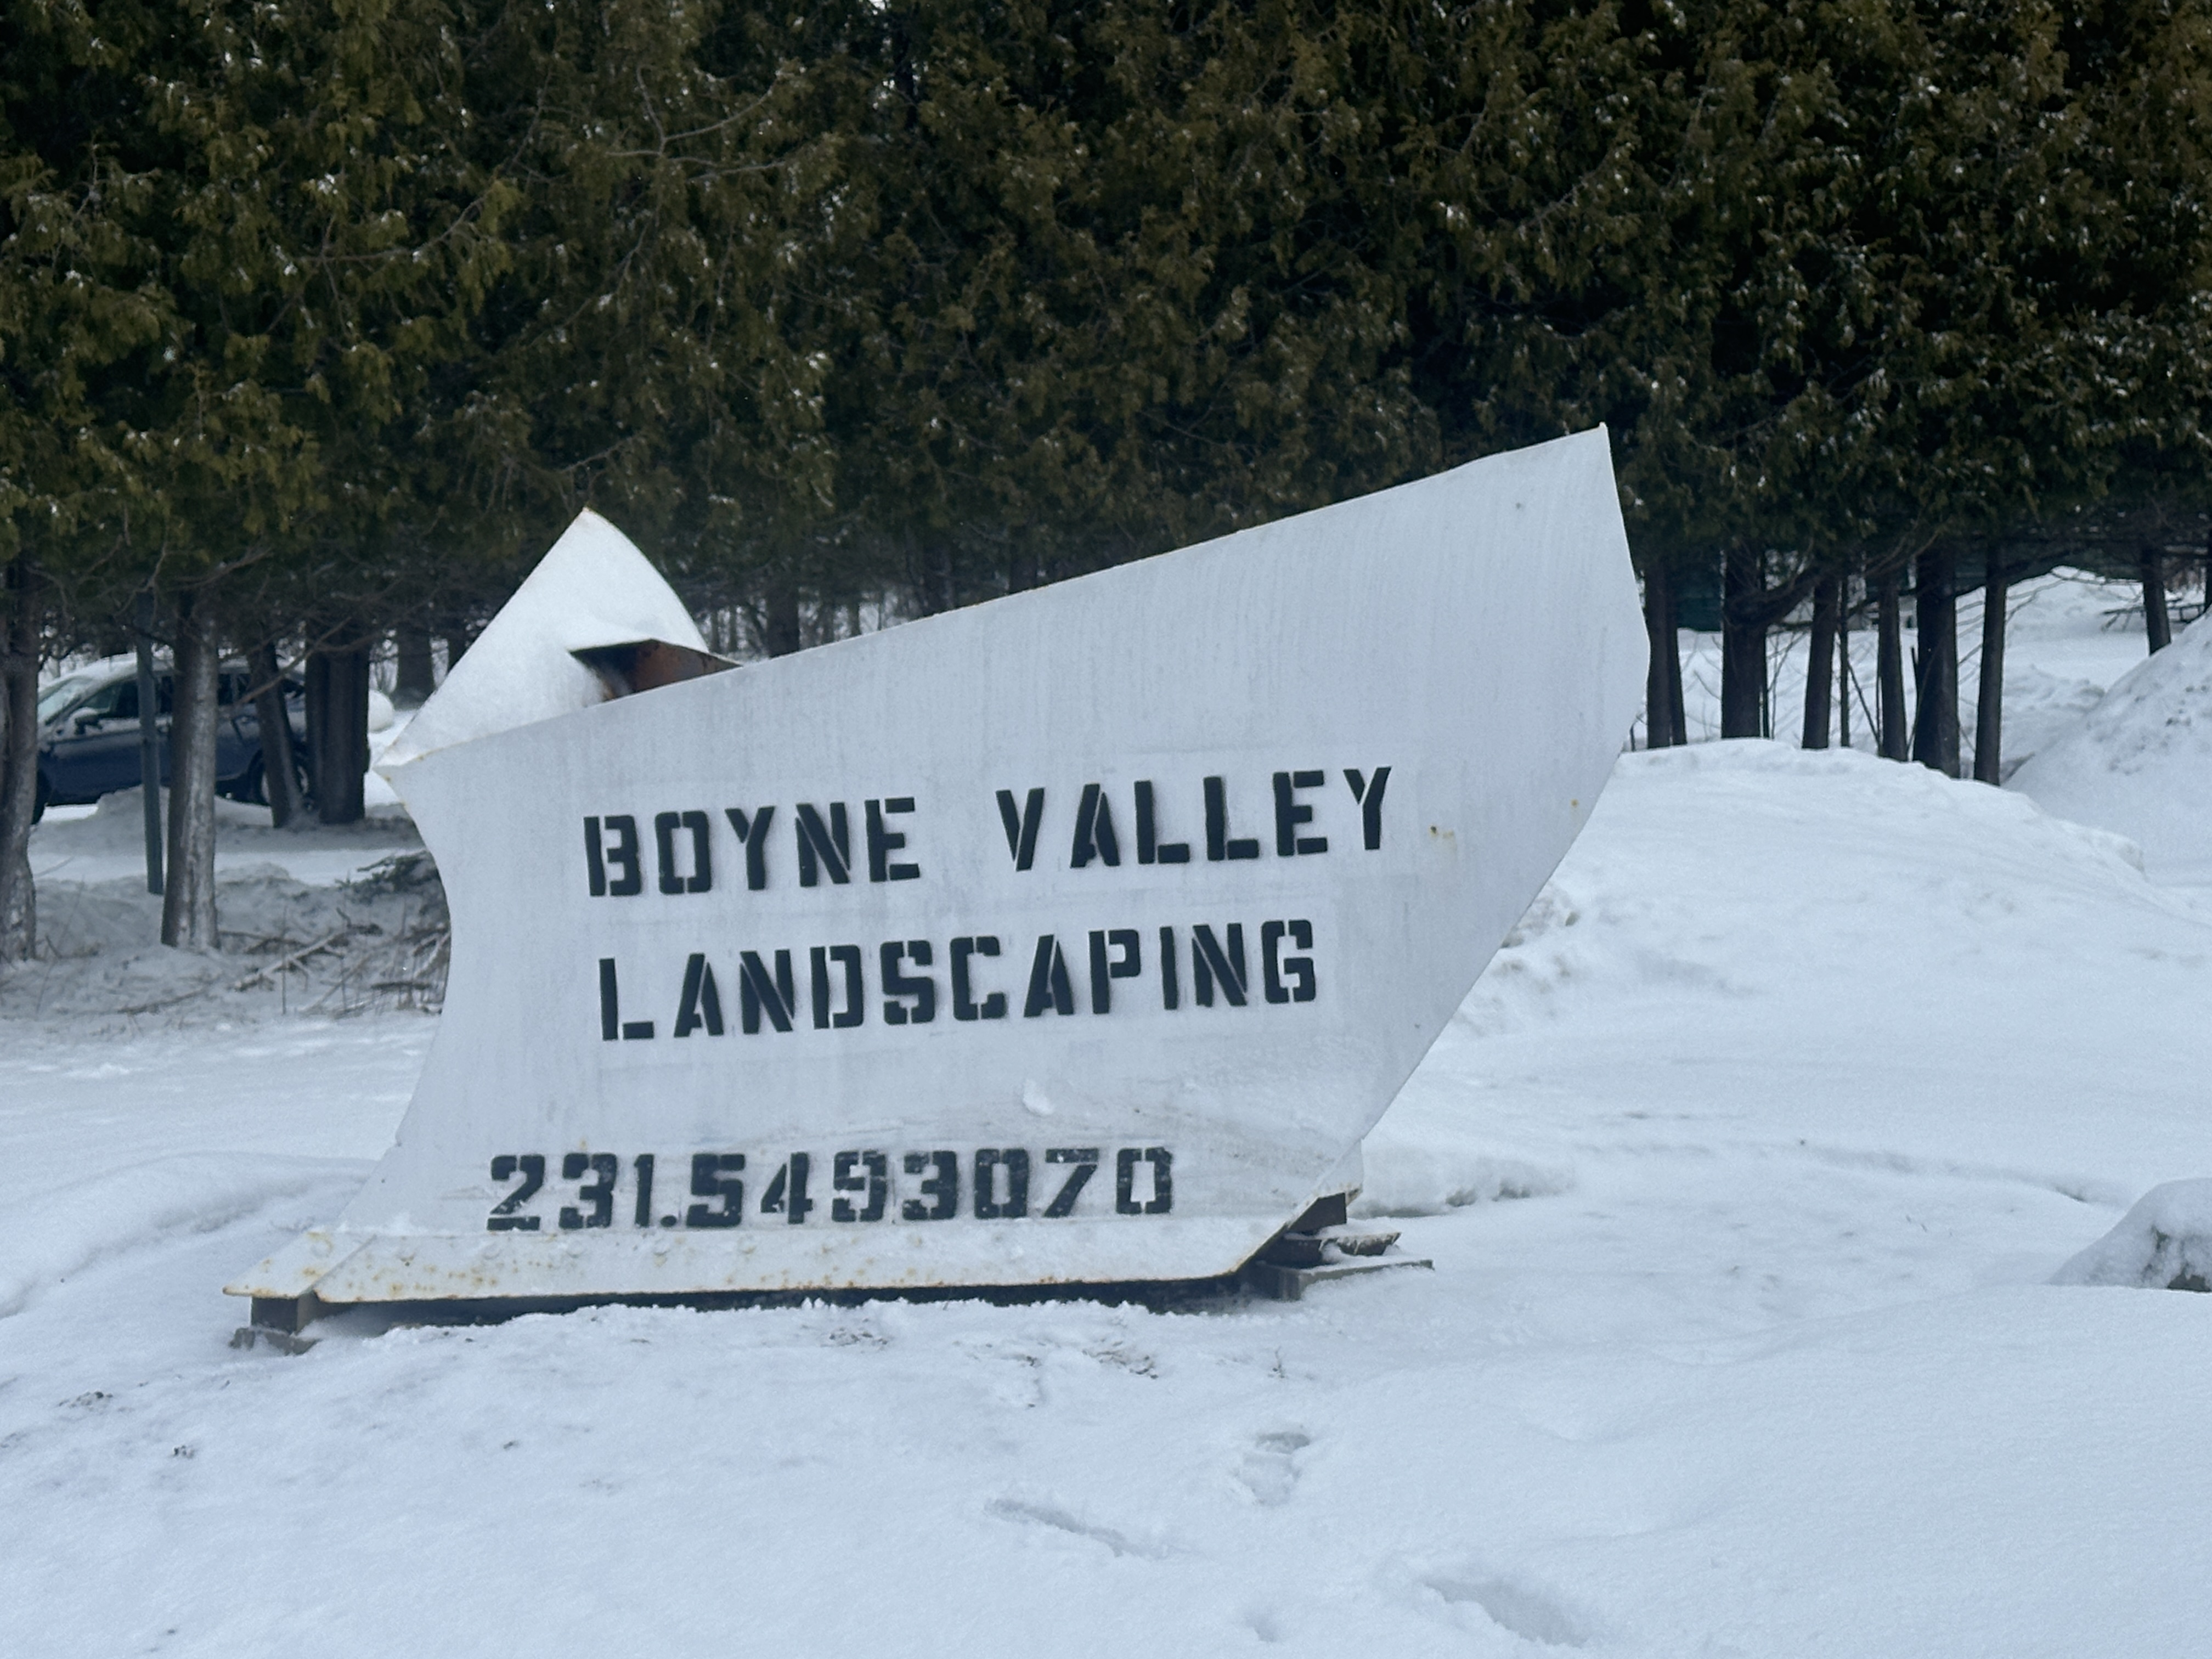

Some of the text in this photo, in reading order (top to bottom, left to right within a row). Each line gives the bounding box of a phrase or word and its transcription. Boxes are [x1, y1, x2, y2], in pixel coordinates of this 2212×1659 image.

[583, 766, 1392, 898] BOYNE VALLEY
[599, 918, 1317, 1042] LANDSCAPING
[486, 1146, 1173, 1232] 231.5493070
